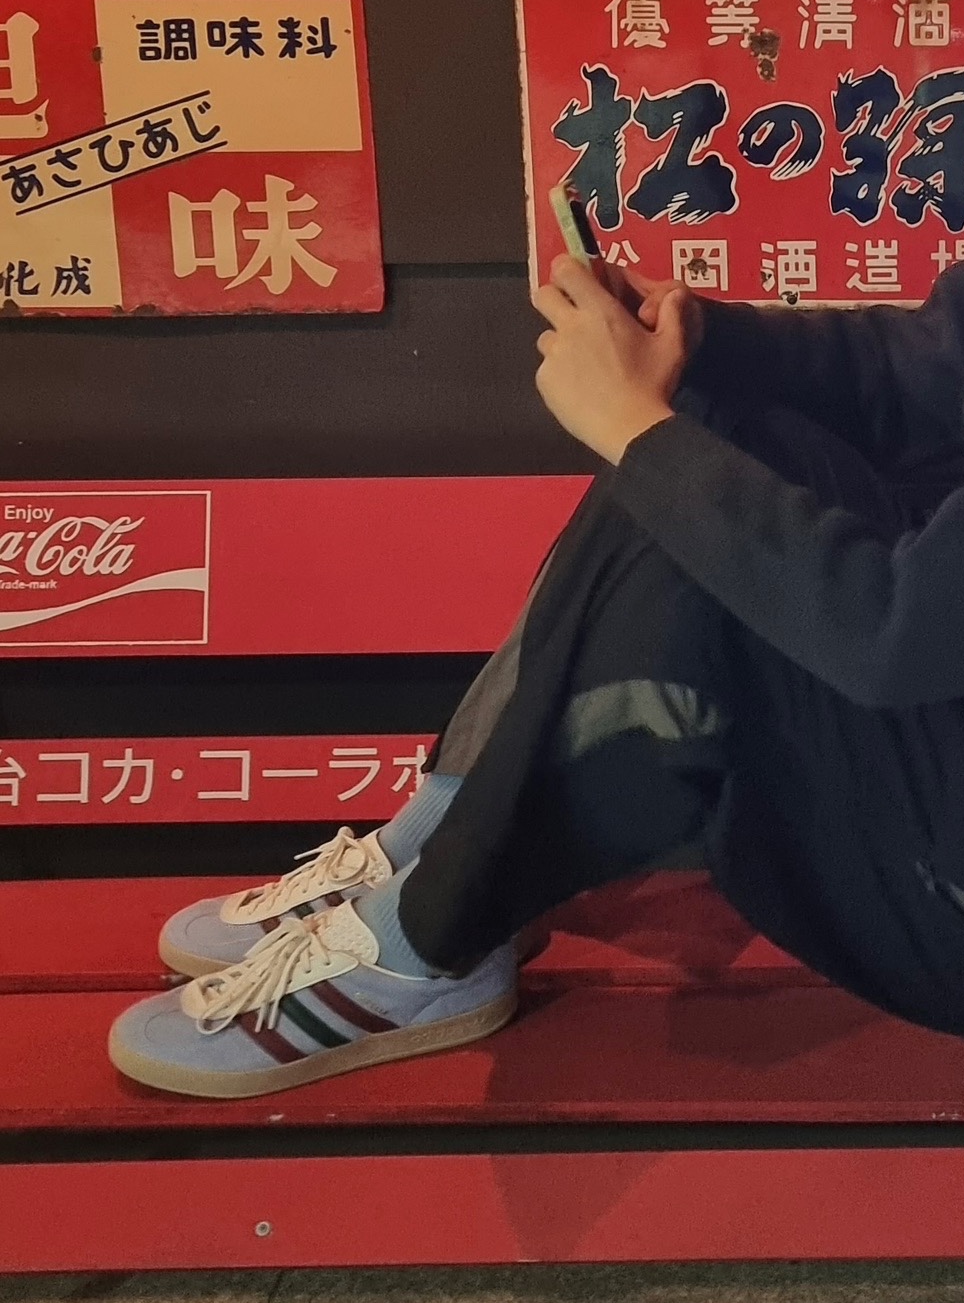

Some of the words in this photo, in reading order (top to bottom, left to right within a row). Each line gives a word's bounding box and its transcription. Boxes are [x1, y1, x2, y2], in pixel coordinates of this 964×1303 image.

[135, 15, 338, 62] 調味料
[1, 100, 222, 205] あさひあじ
[166, 173, 339, 296] 味
[4, 504, 55, 524] Enjoy
